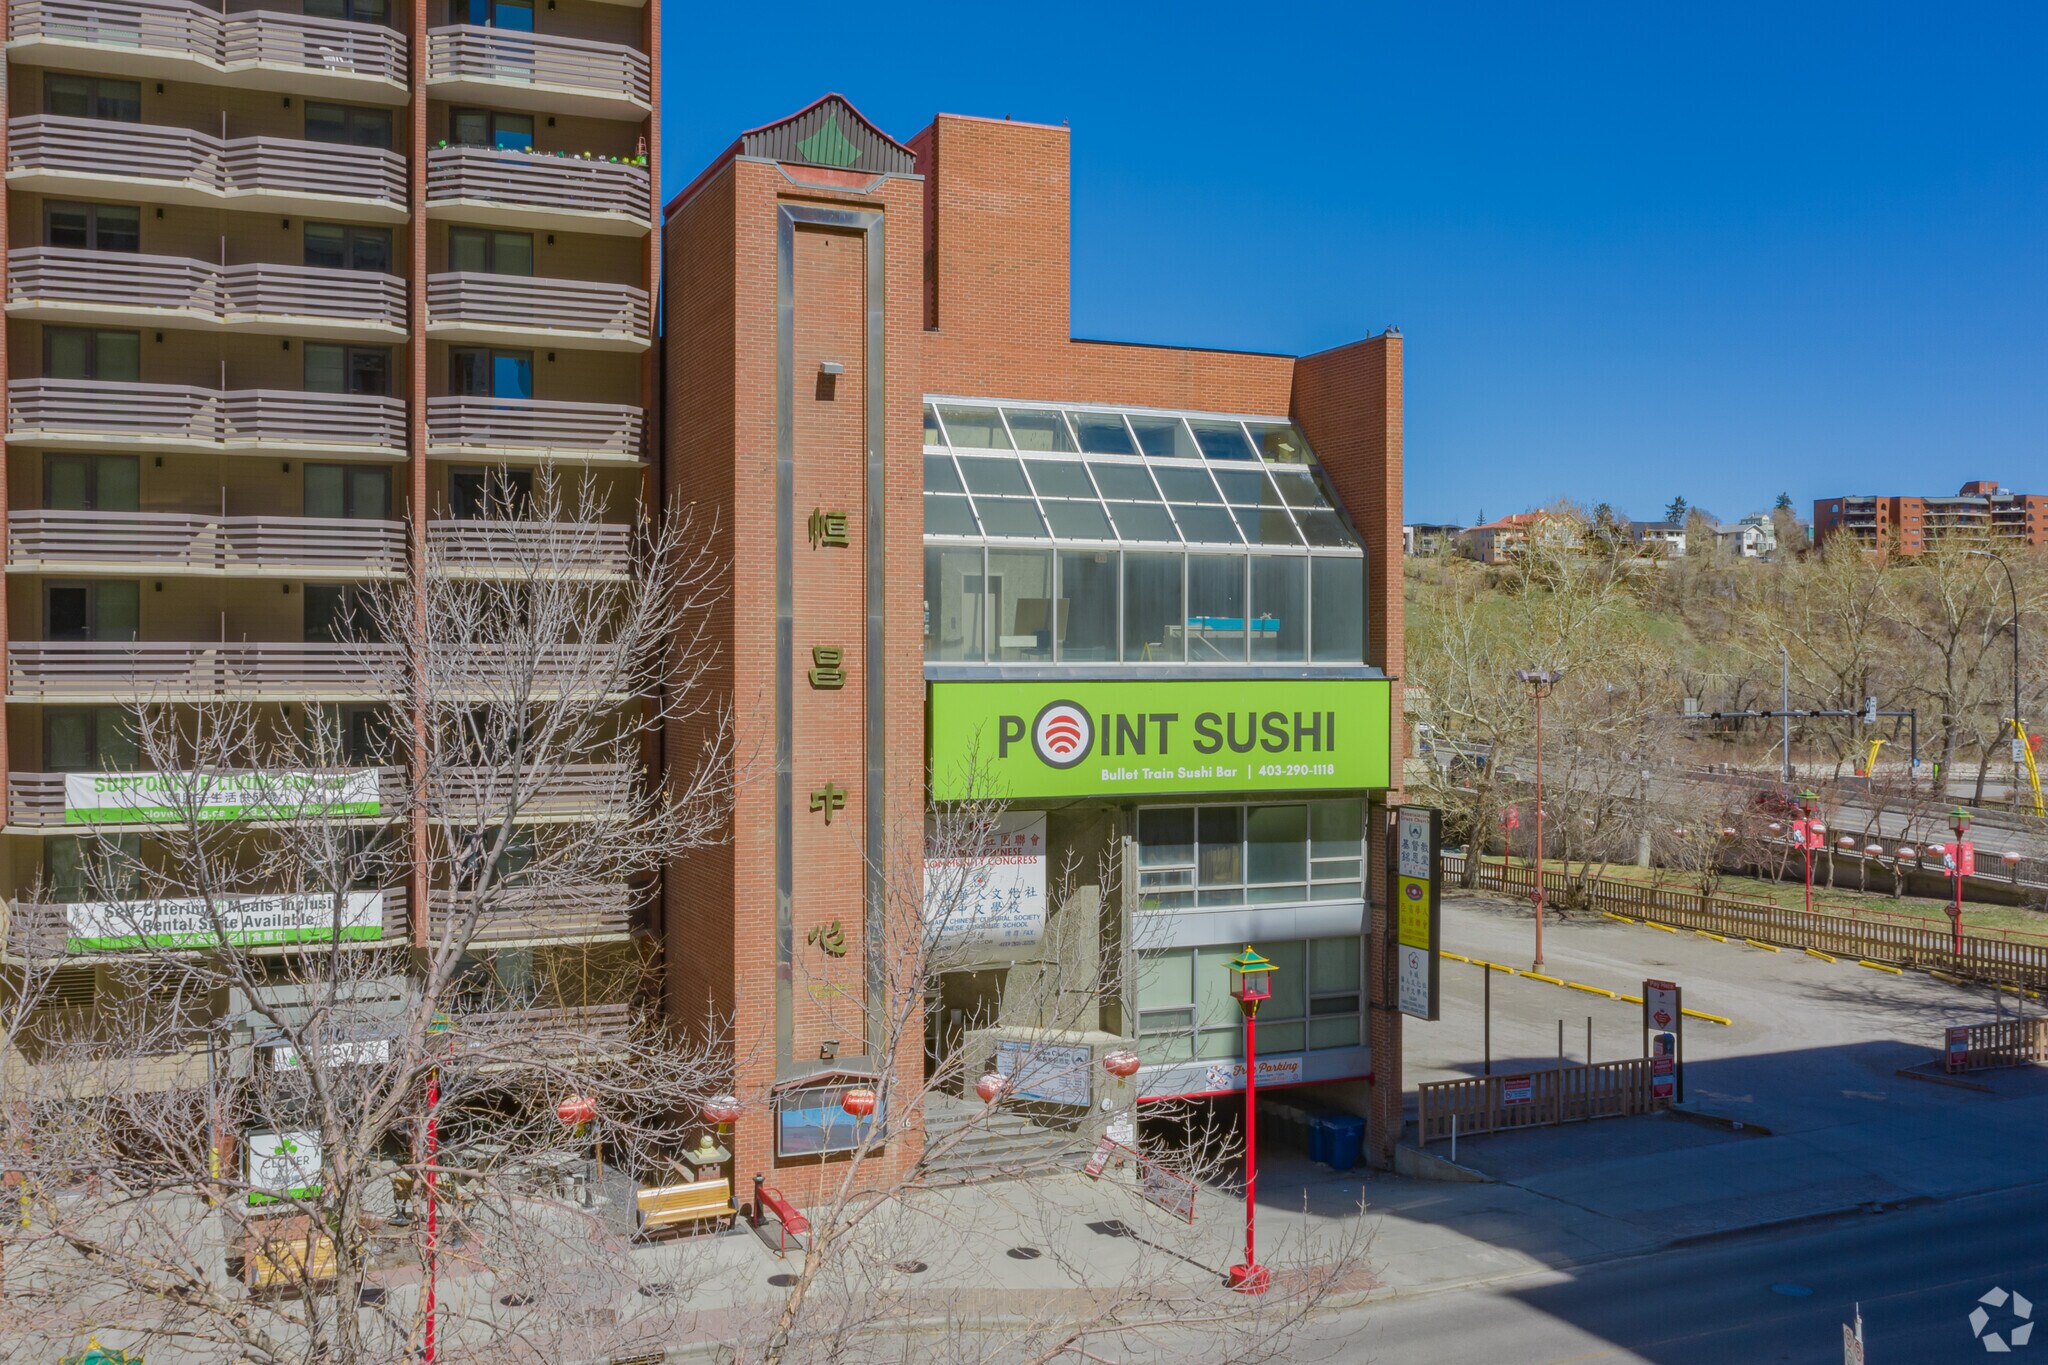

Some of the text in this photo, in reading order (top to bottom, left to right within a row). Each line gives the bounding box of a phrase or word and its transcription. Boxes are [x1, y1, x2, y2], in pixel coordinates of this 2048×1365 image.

[999, 699, 1335, 770] POINT SUSHI
[1101, 764, 1335, 781] Bullet Train Sushi Bar 403-290-1118
[94, 776, 208, 793] SUPPORTE
[924, 856, 1038, 869] OMMUNTY CONGRESS
[105, 901, 212, 918] Sef-Catering
[228, 896, 348, 913] Meals-Inclusie
[143, 918, 193, 932] Rental
[198, 915, 238, 930] Sute
[935, 925, 964, 934] CINESE
[1232, 1065, 1257, 1077] Fr
[1259, 1061, 1299, 1074] Parking
